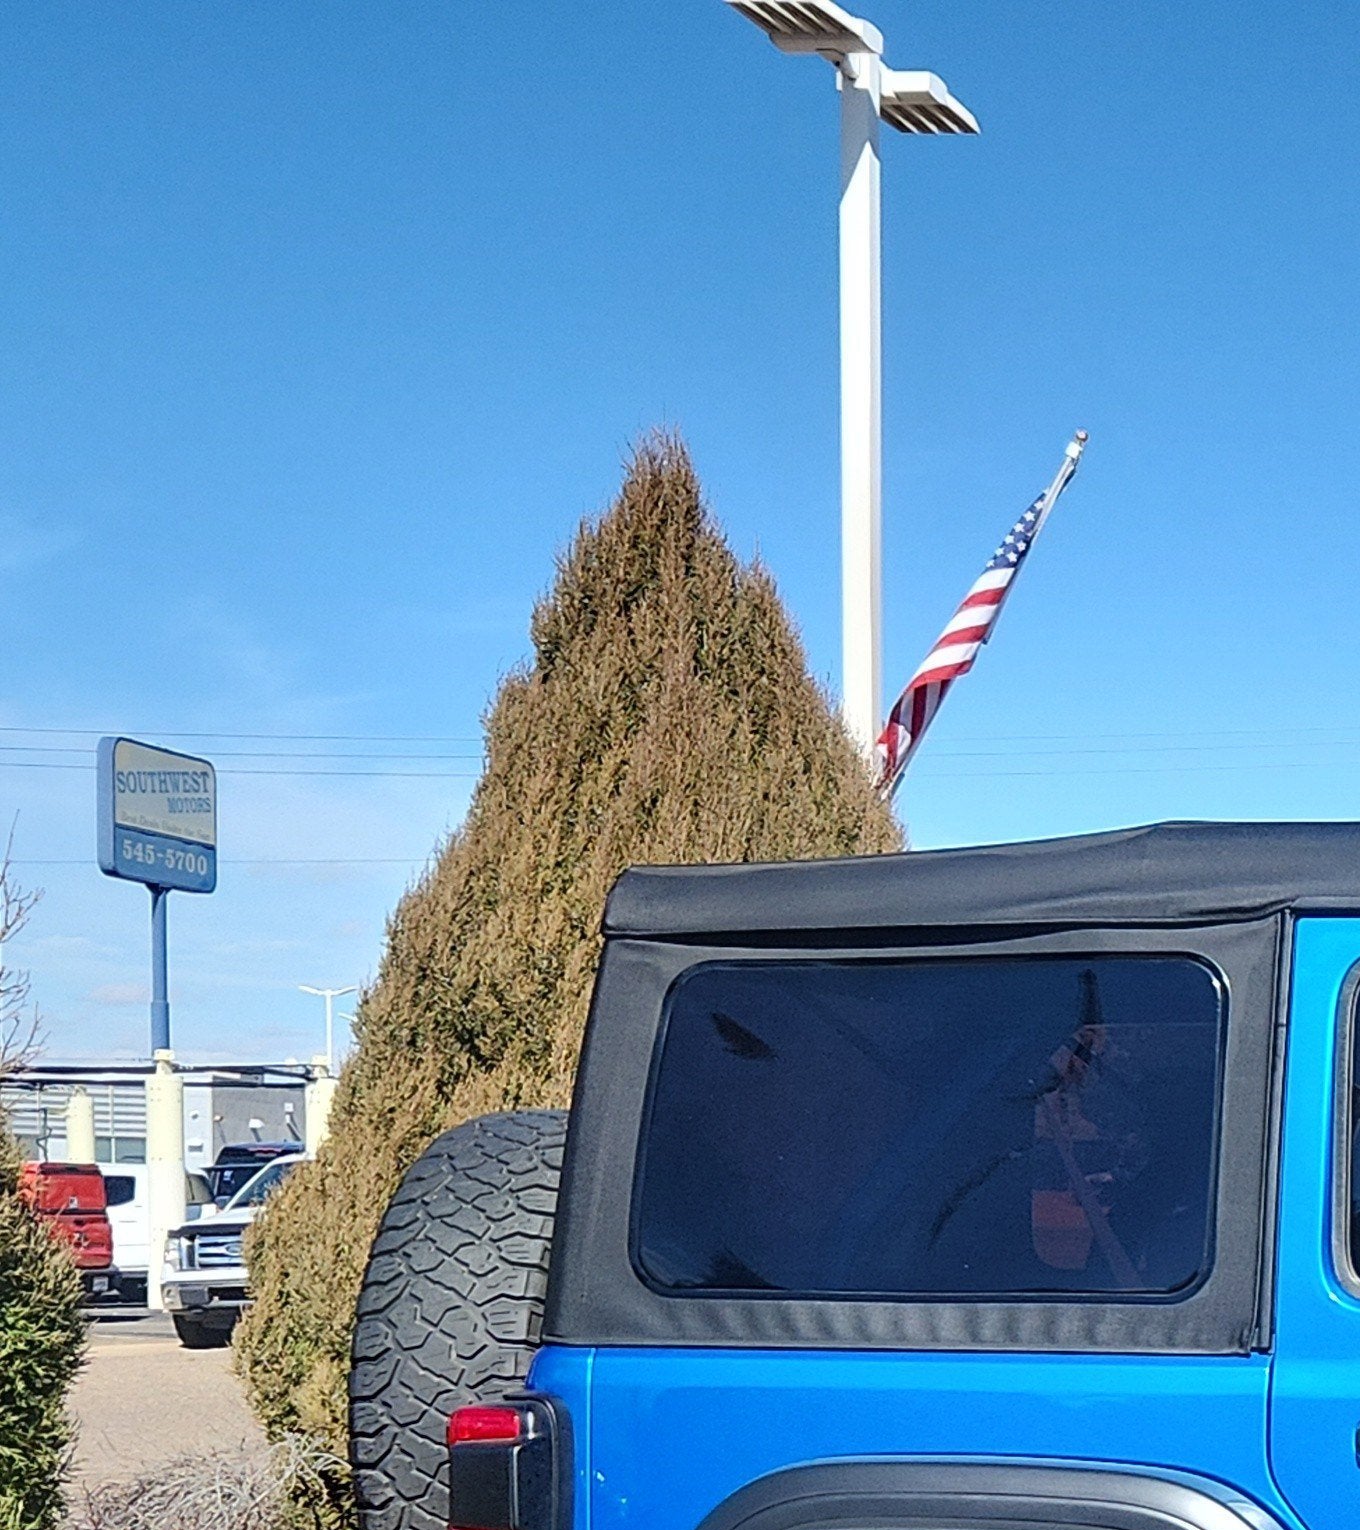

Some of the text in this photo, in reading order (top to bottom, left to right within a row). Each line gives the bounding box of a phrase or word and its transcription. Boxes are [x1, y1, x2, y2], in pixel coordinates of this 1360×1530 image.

[116, 771, 210, 794] SOUTHWEST
[167, 797, 211, 813] MOTORS
[122, 838, 208, 876] 545-5700
